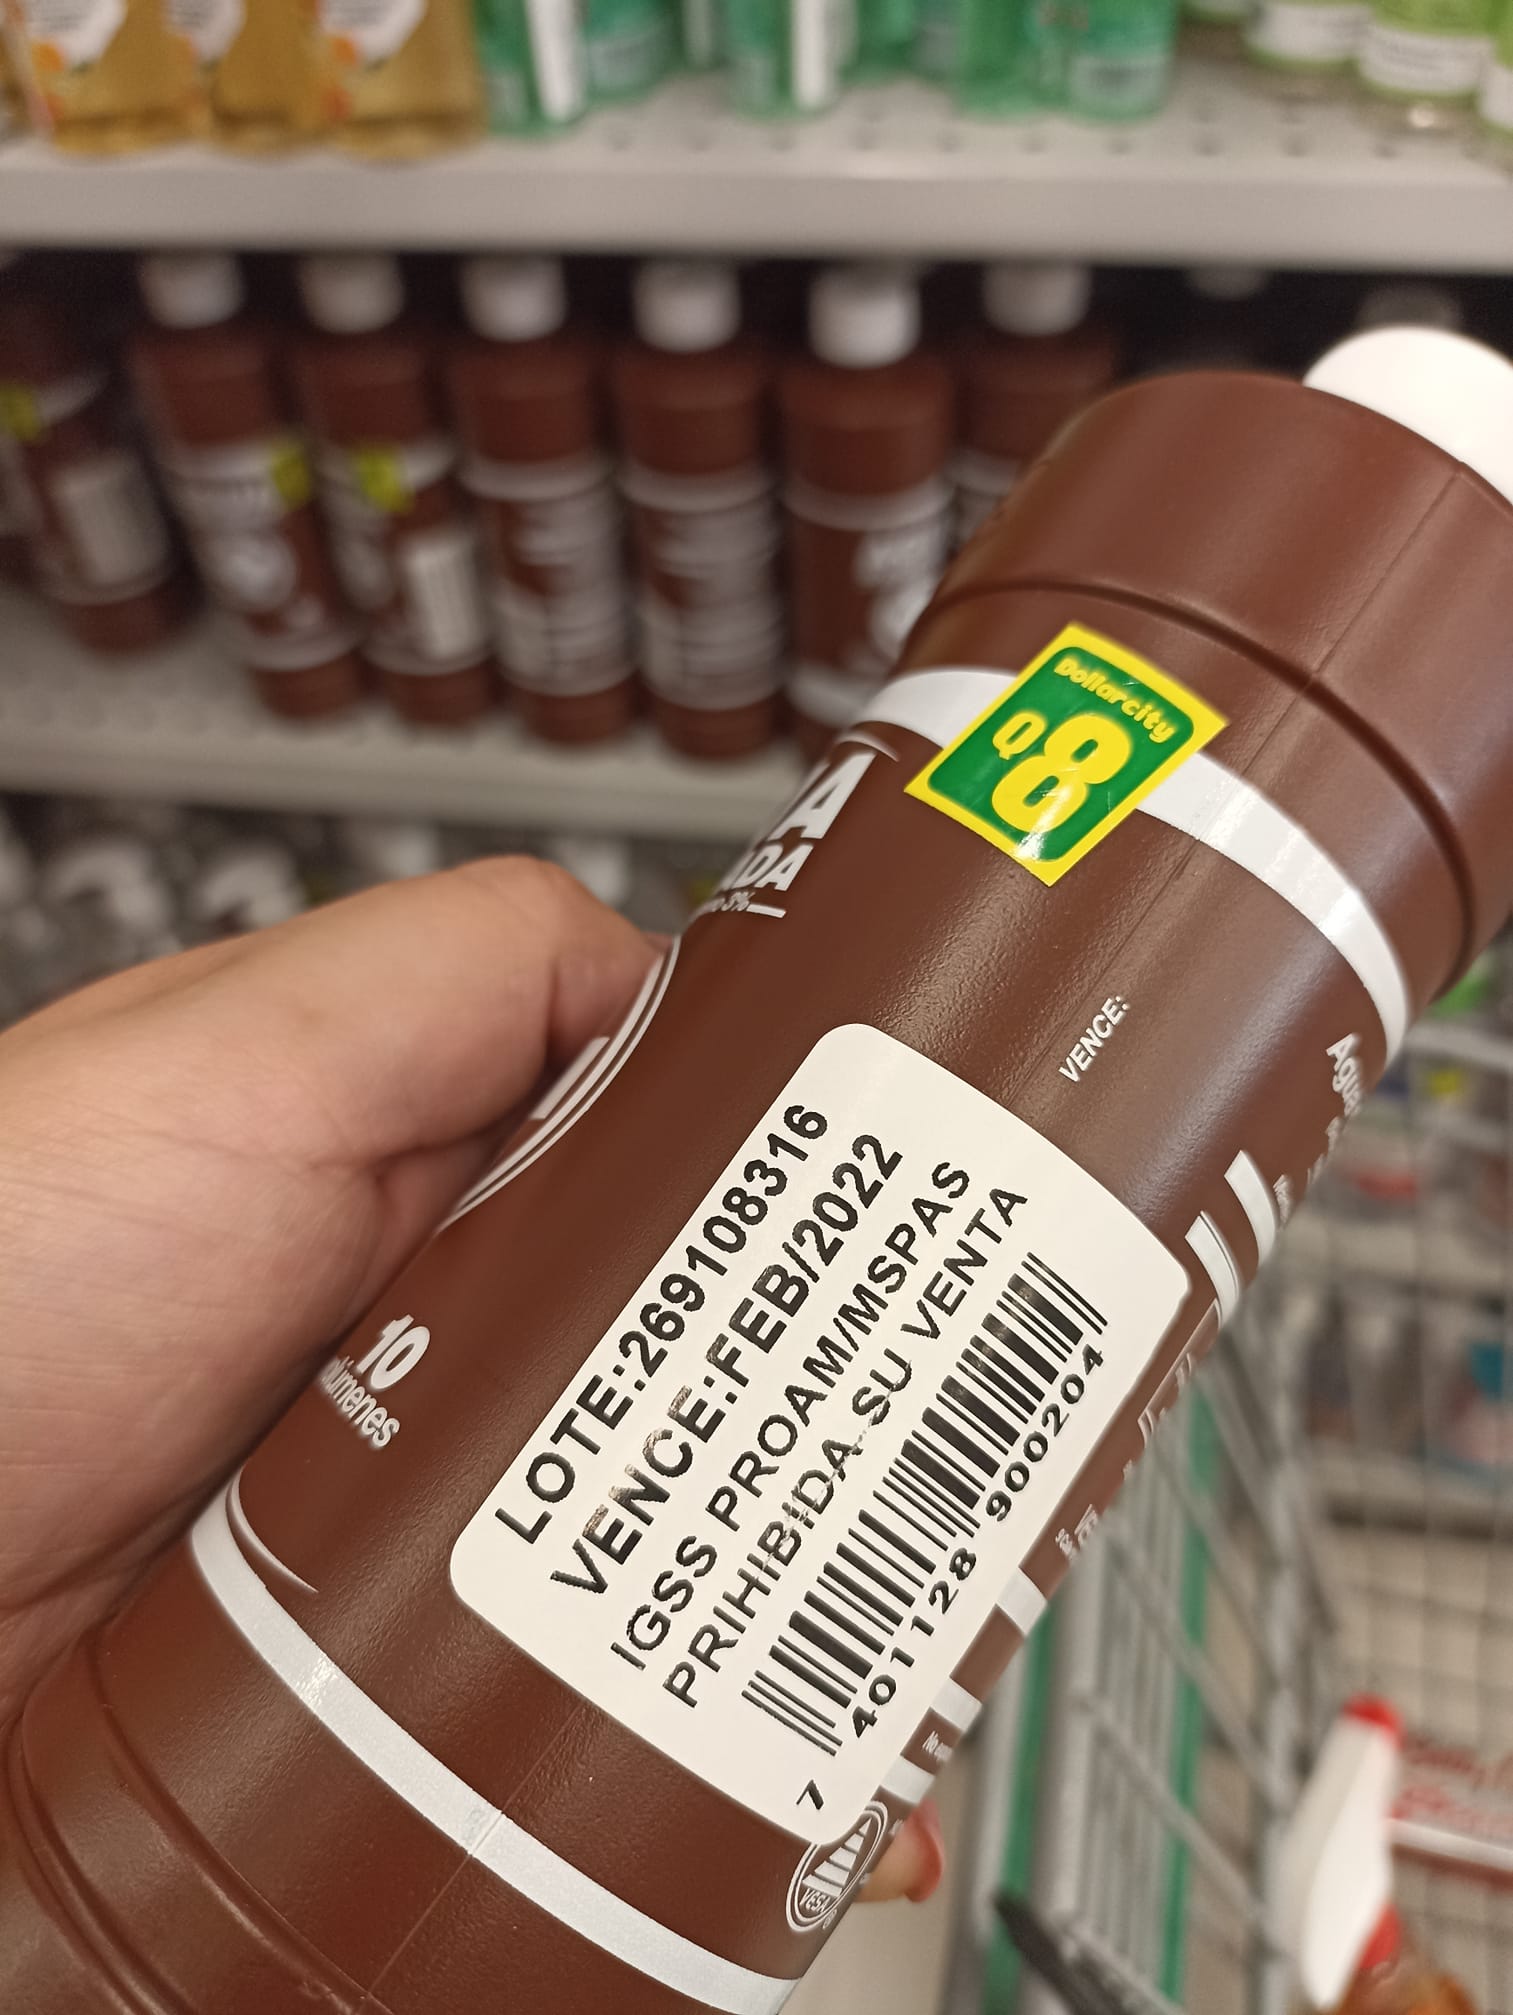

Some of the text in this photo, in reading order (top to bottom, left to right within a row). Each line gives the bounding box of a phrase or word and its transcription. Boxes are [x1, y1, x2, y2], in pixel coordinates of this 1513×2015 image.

[1053, 655, 1176, 743] Dollarcity
[757, 752, 877, 840] A
[991, 711, 1131, 833] Q 8
[718, 842, 814, 891] DA
[1058, 996, 1130, 1082] VENCE:
[356, 1314, 431, 1390] 10
[495, 1105, 828, 1544] LOTE:269108316
[551, 1135, 904, 1595] VENCE:FEB/2022
[611, 1161, 970, 1671] IGSS PROAM/MSPAS
[663, 1188, 1028, 1709] PRIHIBIDA SU VENTA
[796, 1343, 1103, 1811] 7 401128 900204
[799, 1887, 831, 1913] VESA
